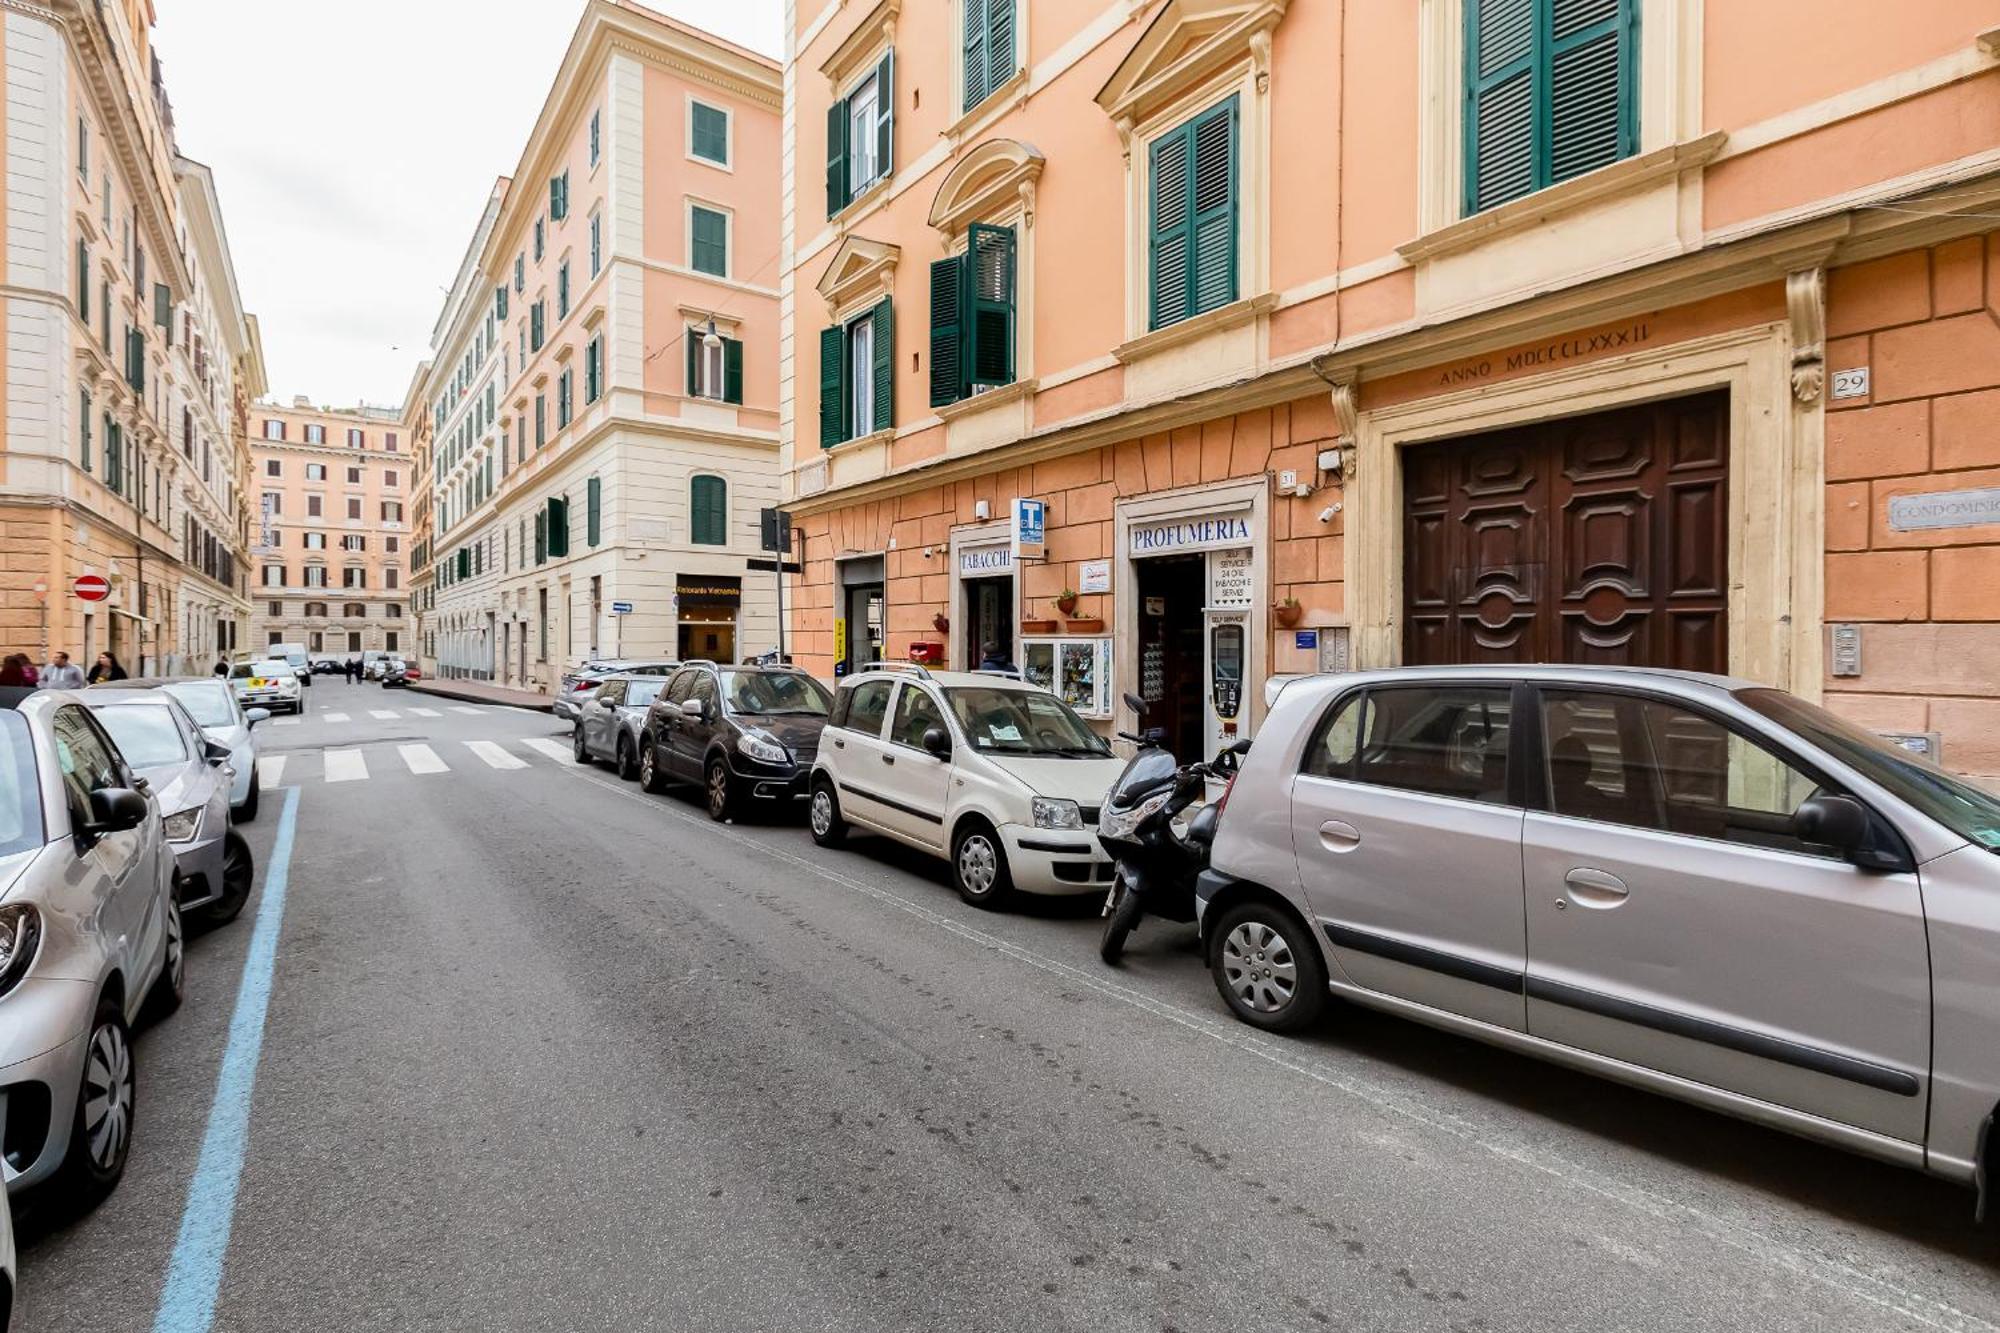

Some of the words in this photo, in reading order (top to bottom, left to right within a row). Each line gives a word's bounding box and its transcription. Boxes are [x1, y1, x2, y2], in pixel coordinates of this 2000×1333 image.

[1439, 361, 1492, 386] ANNO
[1506, 324, 1649, 371] MDCCCLXXXII
[1836, 375, 1865, 393] 29
[1134, 517, 1249, 549] PROFUMERIA
[960, 550, 1010, 569] TABACCHI
